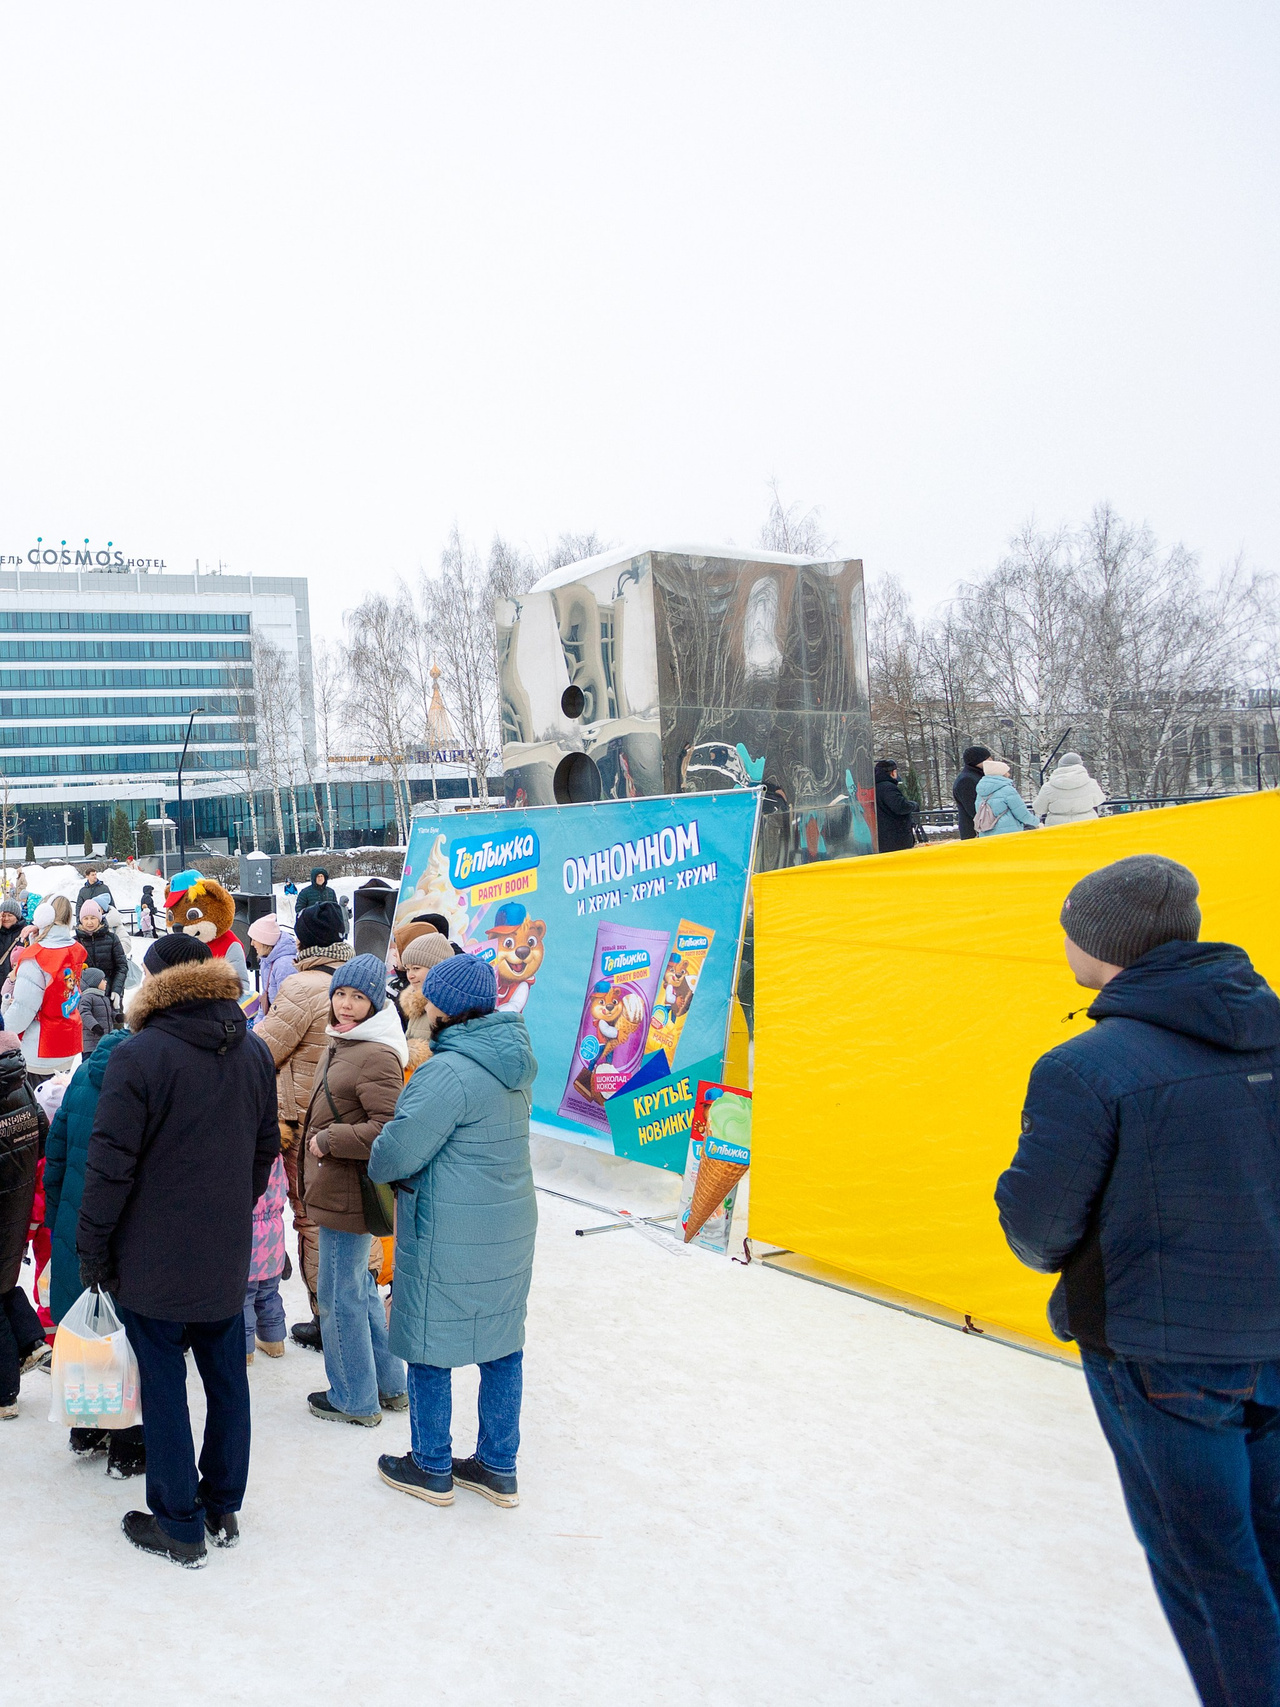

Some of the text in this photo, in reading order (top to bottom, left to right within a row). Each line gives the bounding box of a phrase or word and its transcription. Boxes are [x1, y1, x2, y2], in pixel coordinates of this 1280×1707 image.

[27, 549, 167, 568] COSMOS HOTEL
[562, 819, 701, 895] ОМНОМНОМ
[478, 883, 503, 902] PARTY
[577, 898, 586, 917] И
[588, 888, 622, 914] ХРУМ
[631, 875, 666, 903] ХРУМ
[676, 861, 718, 891] ХРУМ!
[616, 968, 648, 984] PARTY BOOM
[652, 1032, 674, 1048] МАНГО
[596, 1082, 617, 1091] КОКОС
[633, 1075, 694, 1120] КРУТЫЕ
[637, 1107, 695, 1147] НОВИНКИ
